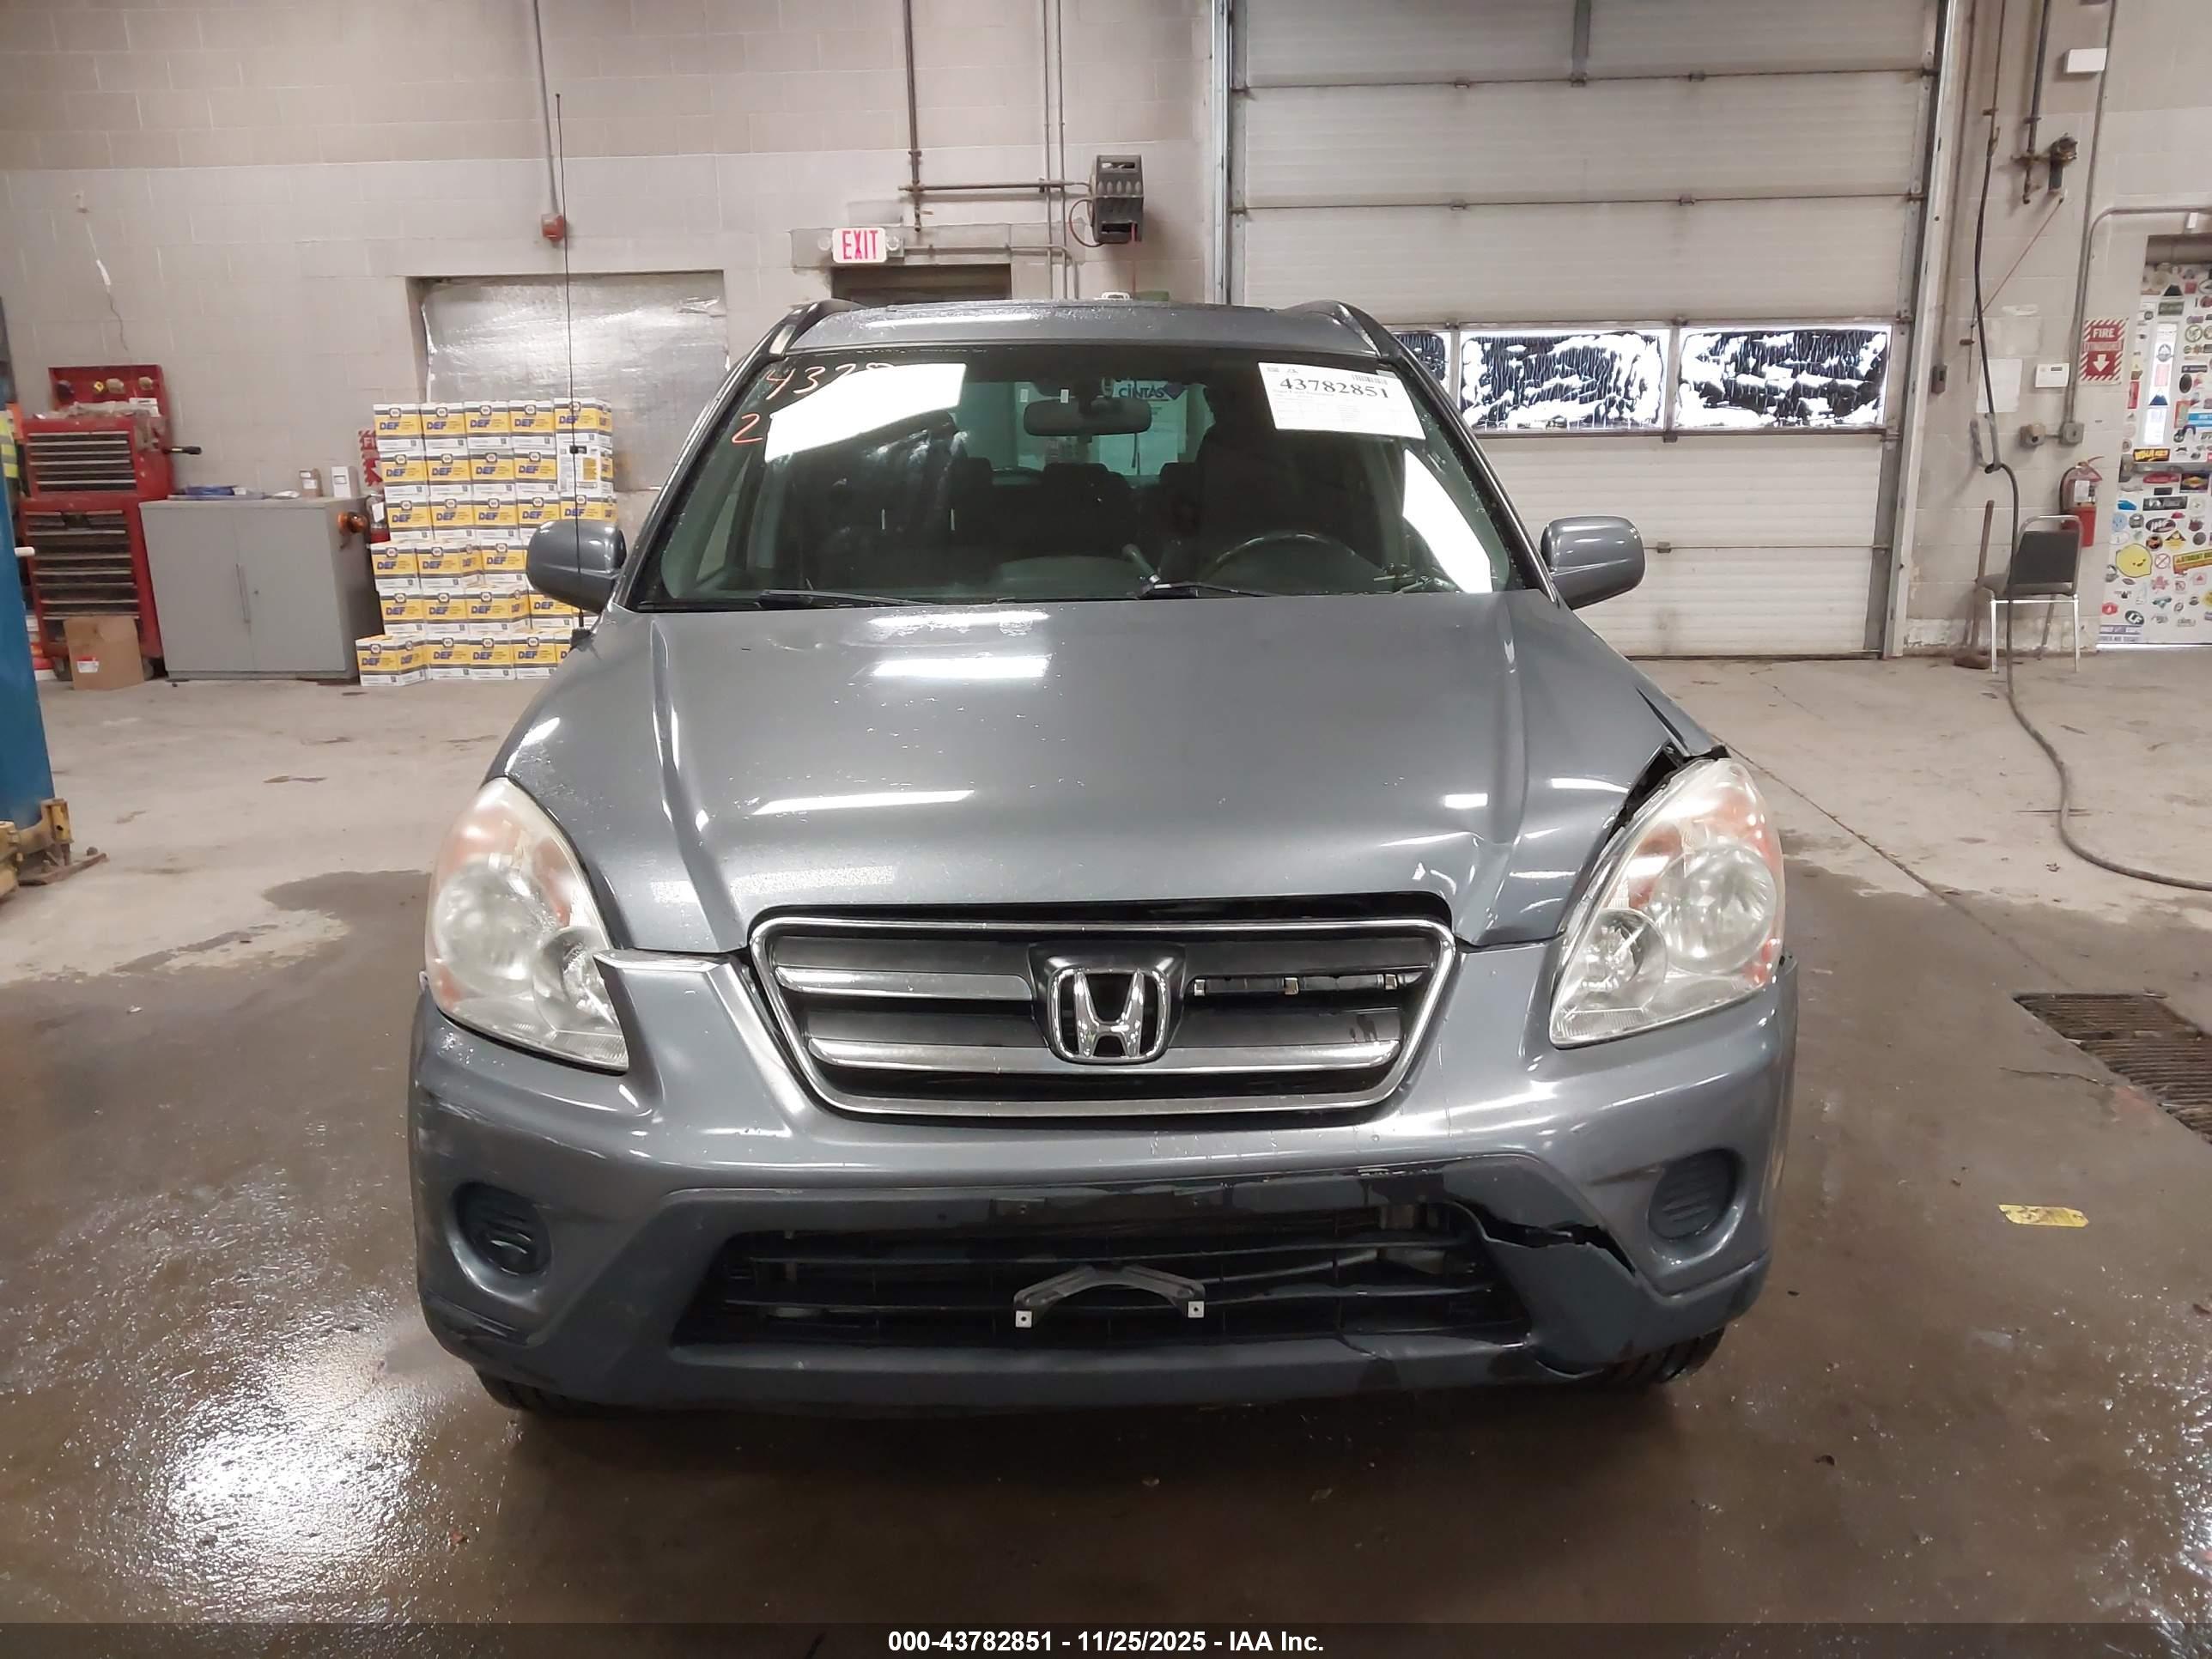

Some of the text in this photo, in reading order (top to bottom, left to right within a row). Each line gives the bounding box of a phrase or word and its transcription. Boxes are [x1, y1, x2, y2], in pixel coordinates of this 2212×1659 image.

[842, 230, 878, 260] EXIT
[2093, 327, 2116, 338] FIRE
[1279, 378, 1389, 399] 43782851
[470, 418, 490, 428] DEF
[514, 418, 535, 428] DEF
[559, 415, 580, 424] DEF
[380, 421, 400, 430] DEF
[426, 420, 447, 430] DEF
[386, 468, 406, 477] DEF
[431, 467, 453, 476] DEF
[476, 466, 496, 475] DEF
[518, 465, 539, 474] DEF
[435, 512, 456, 521] DEF
[478, 512, 499, 521] DEF
[521, 510, 544, 520] DEF
[564, 507, 586, 517] DEF
[392, 514, 411, 523] DEF
[422, 560, 443, 569] DEF
[486, 556, 507, 565] DEF
[376, 561, 398, 570] DEF
[386, 606, 406, 616] DEF
[428, 606, 449, 615] DEF
[471, 605, 492, 614] DEF
[433, 651, 453, 660] DEF
[472, 651, 494, 660] DEF
[518, 650, 538, 659] DEF
[361, 657, 381, 666] DEF
